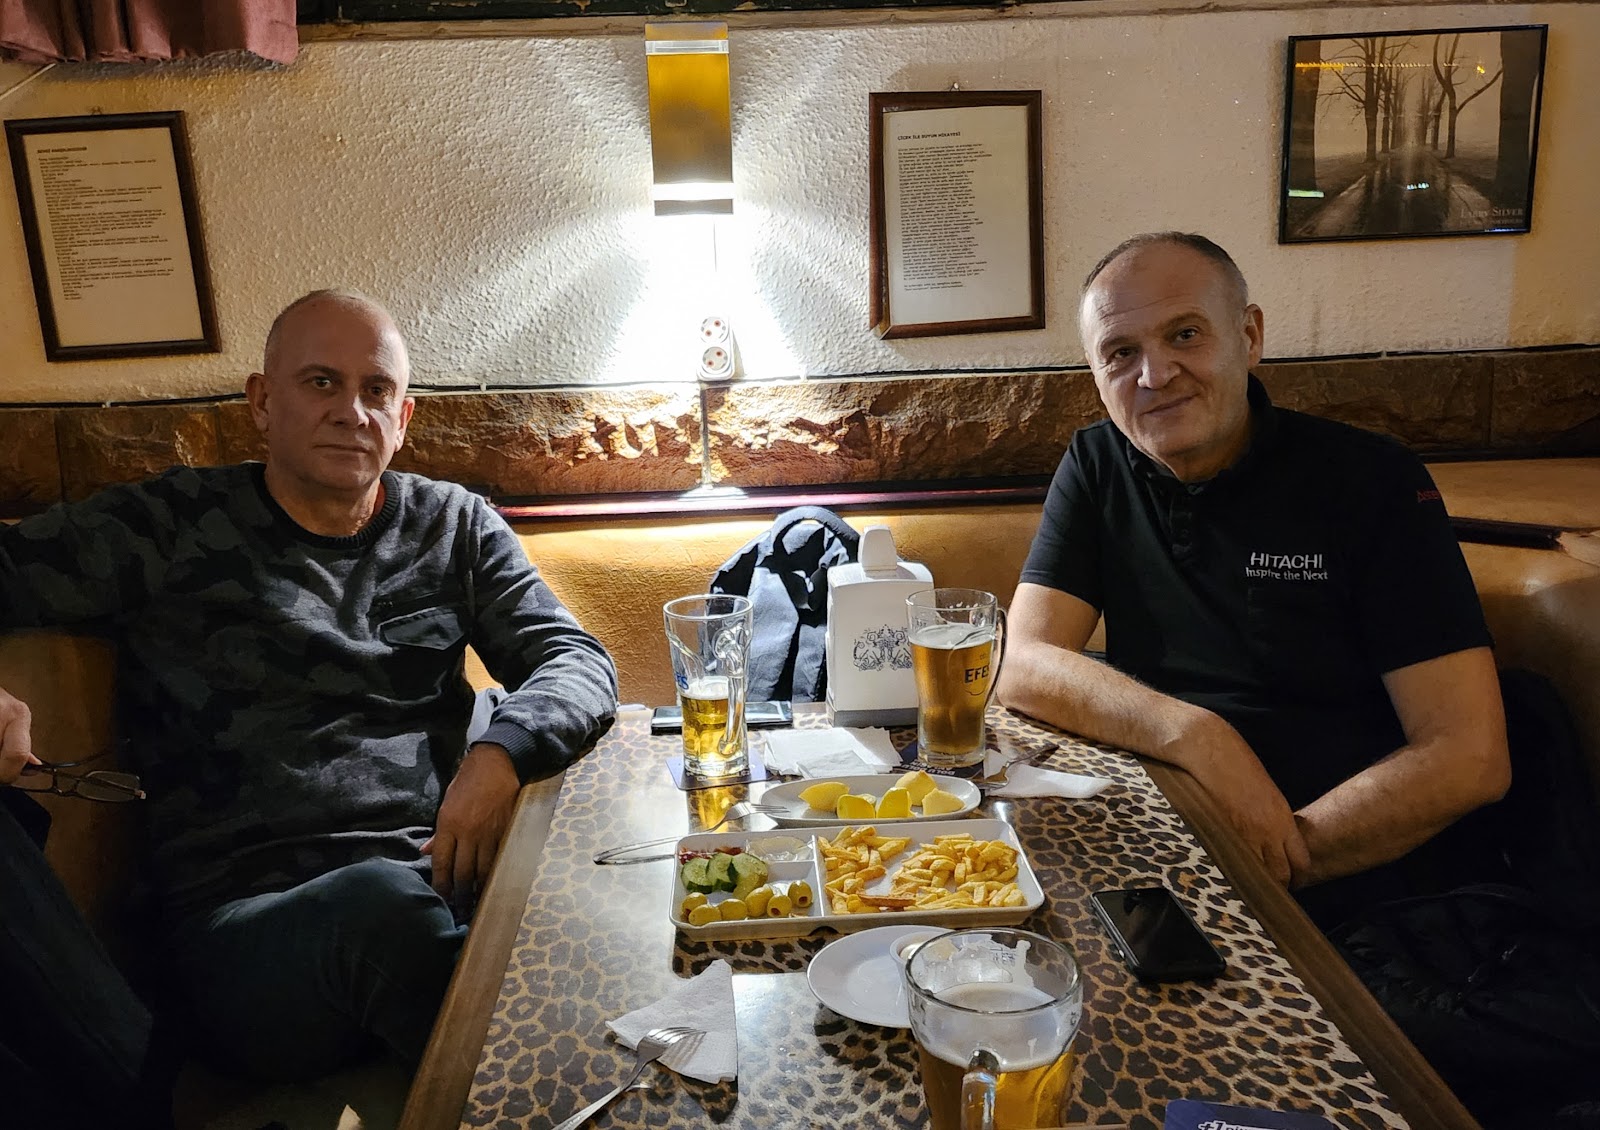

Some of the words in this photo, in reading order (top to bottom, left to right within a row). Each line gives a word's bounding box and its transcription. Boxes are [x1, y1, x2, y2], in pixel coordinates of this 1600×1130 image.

[1250, 552, 1323, 569] HITACHI
[1245, 567, 1281, 579] Inspire
[1283, 570, 1301, 580] the
[1303, 569, 1328, 581] Next
